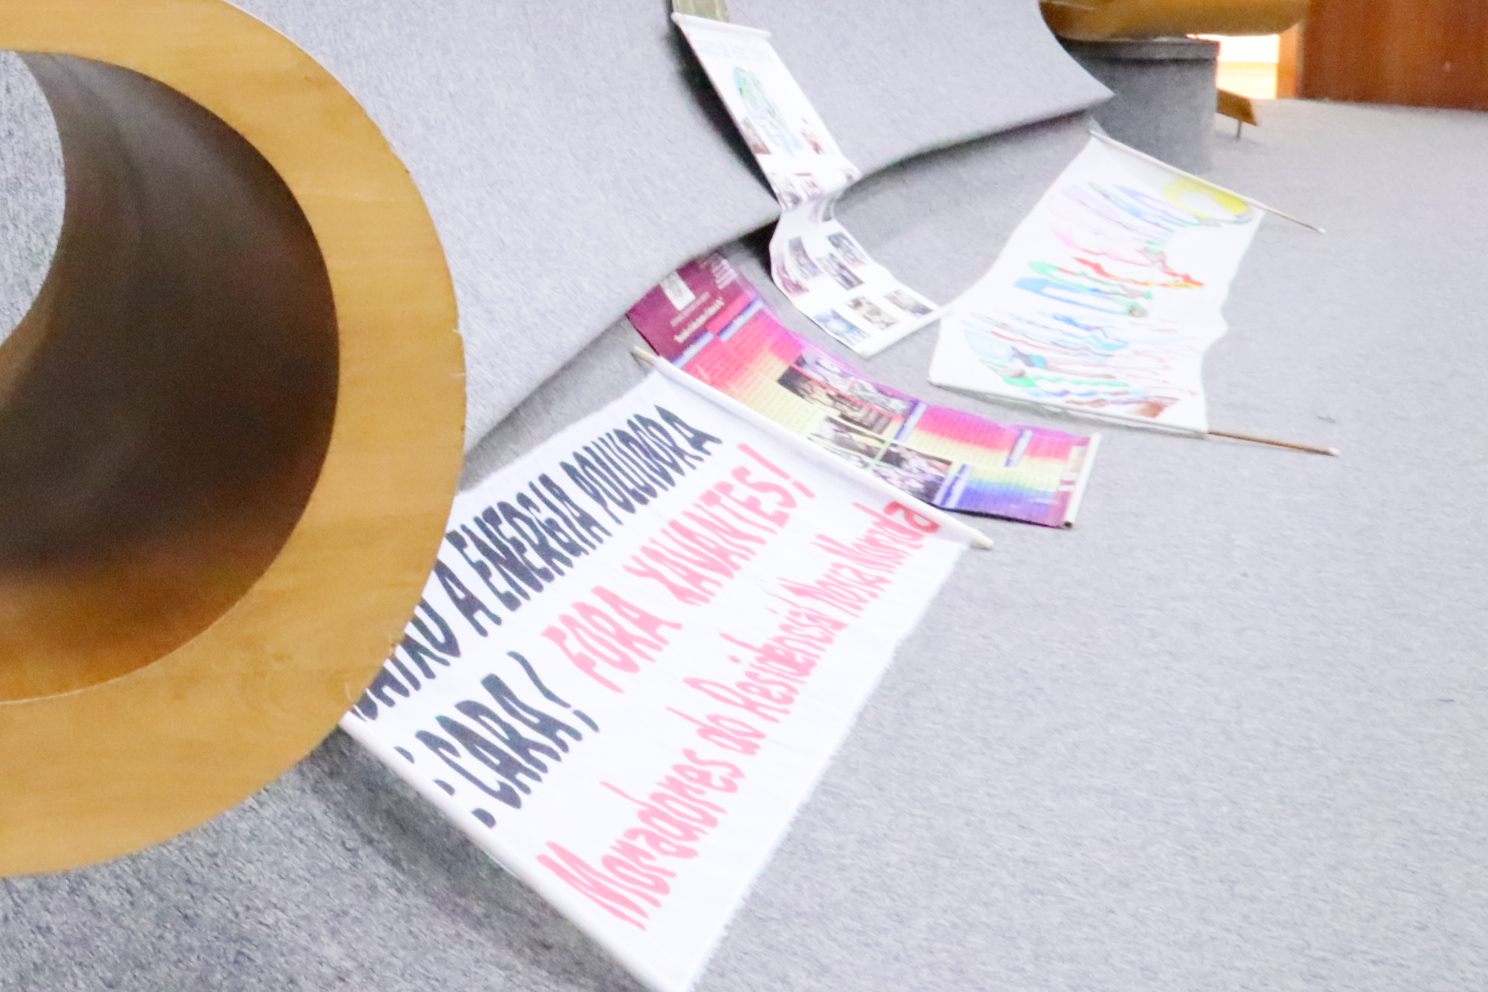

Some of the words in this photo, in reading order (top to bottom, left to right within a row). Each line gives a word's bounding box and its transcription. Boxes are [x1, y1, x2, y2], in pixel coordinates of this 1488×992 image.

[560, 404, 723, 526] POLUIDORA
[434, 557, 502, 638] A
[446, 472, 613, 612] ENERGIA
[775, 561, 894, 619] Nova
[809, 501, 941, 575] Morada
[414, 650, 600, 810] CARA!
[540, 585, 684, 694] FORA
[622, 443, 816, 607] XAVANTES!
[681, 591, 849, 724] Residencial
[665, 706, 768, 757] do
[535, 747, 746, 932] Moradores
